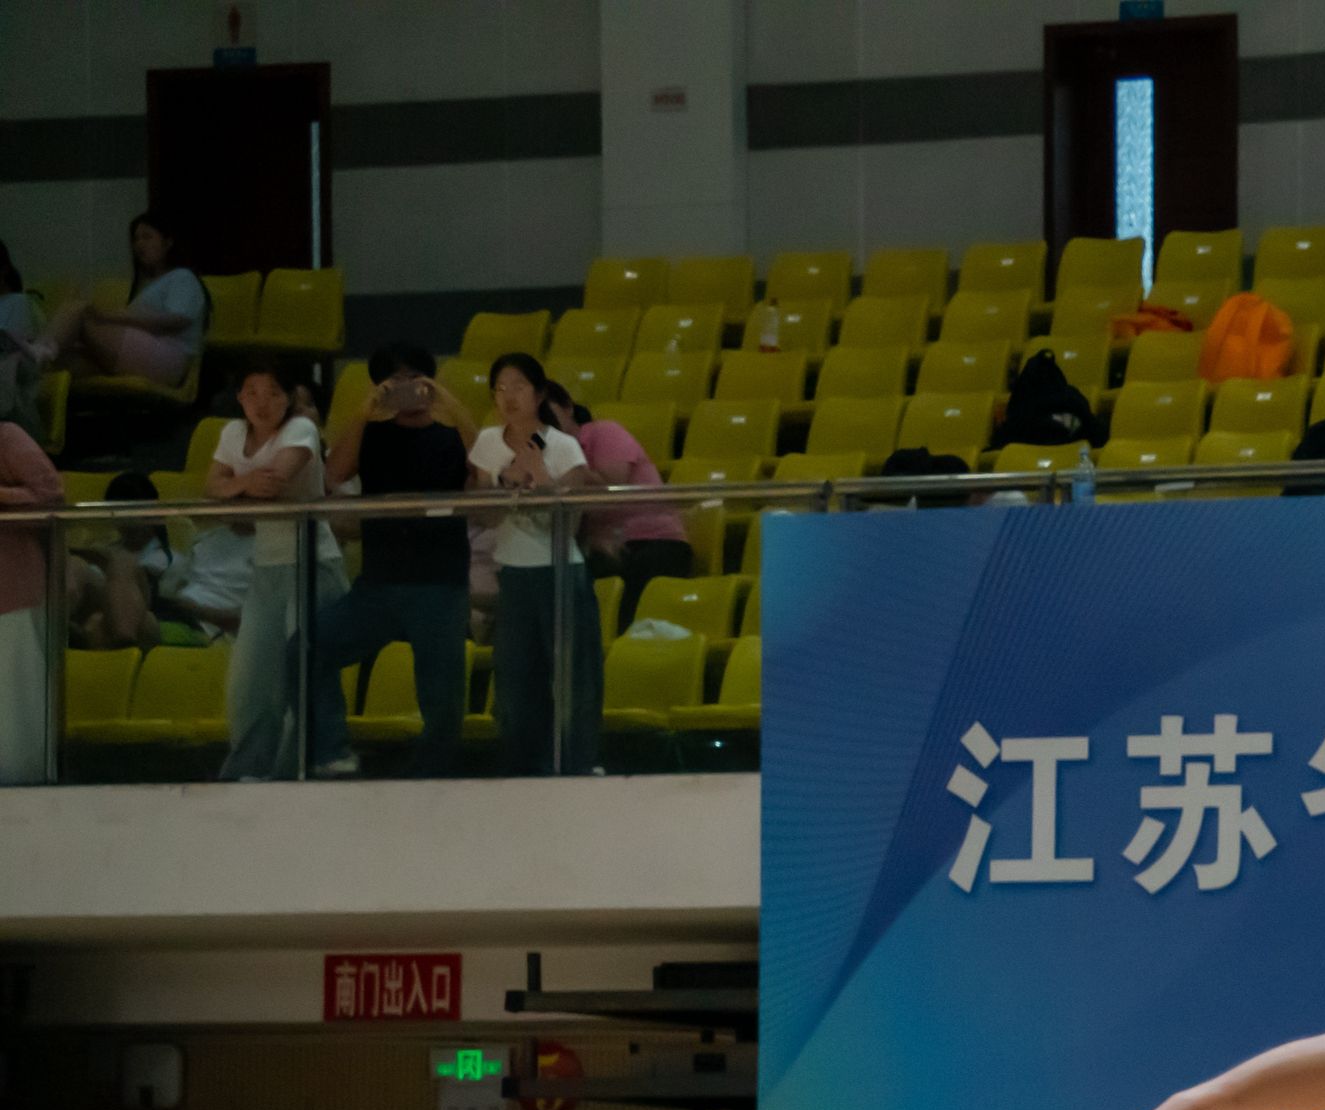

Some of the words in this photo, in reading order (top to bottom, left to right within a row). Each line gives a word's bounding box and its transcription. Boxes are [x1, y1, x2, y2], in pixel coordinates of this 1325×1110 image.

[334, 960, 451, 1017] 南门出入口
